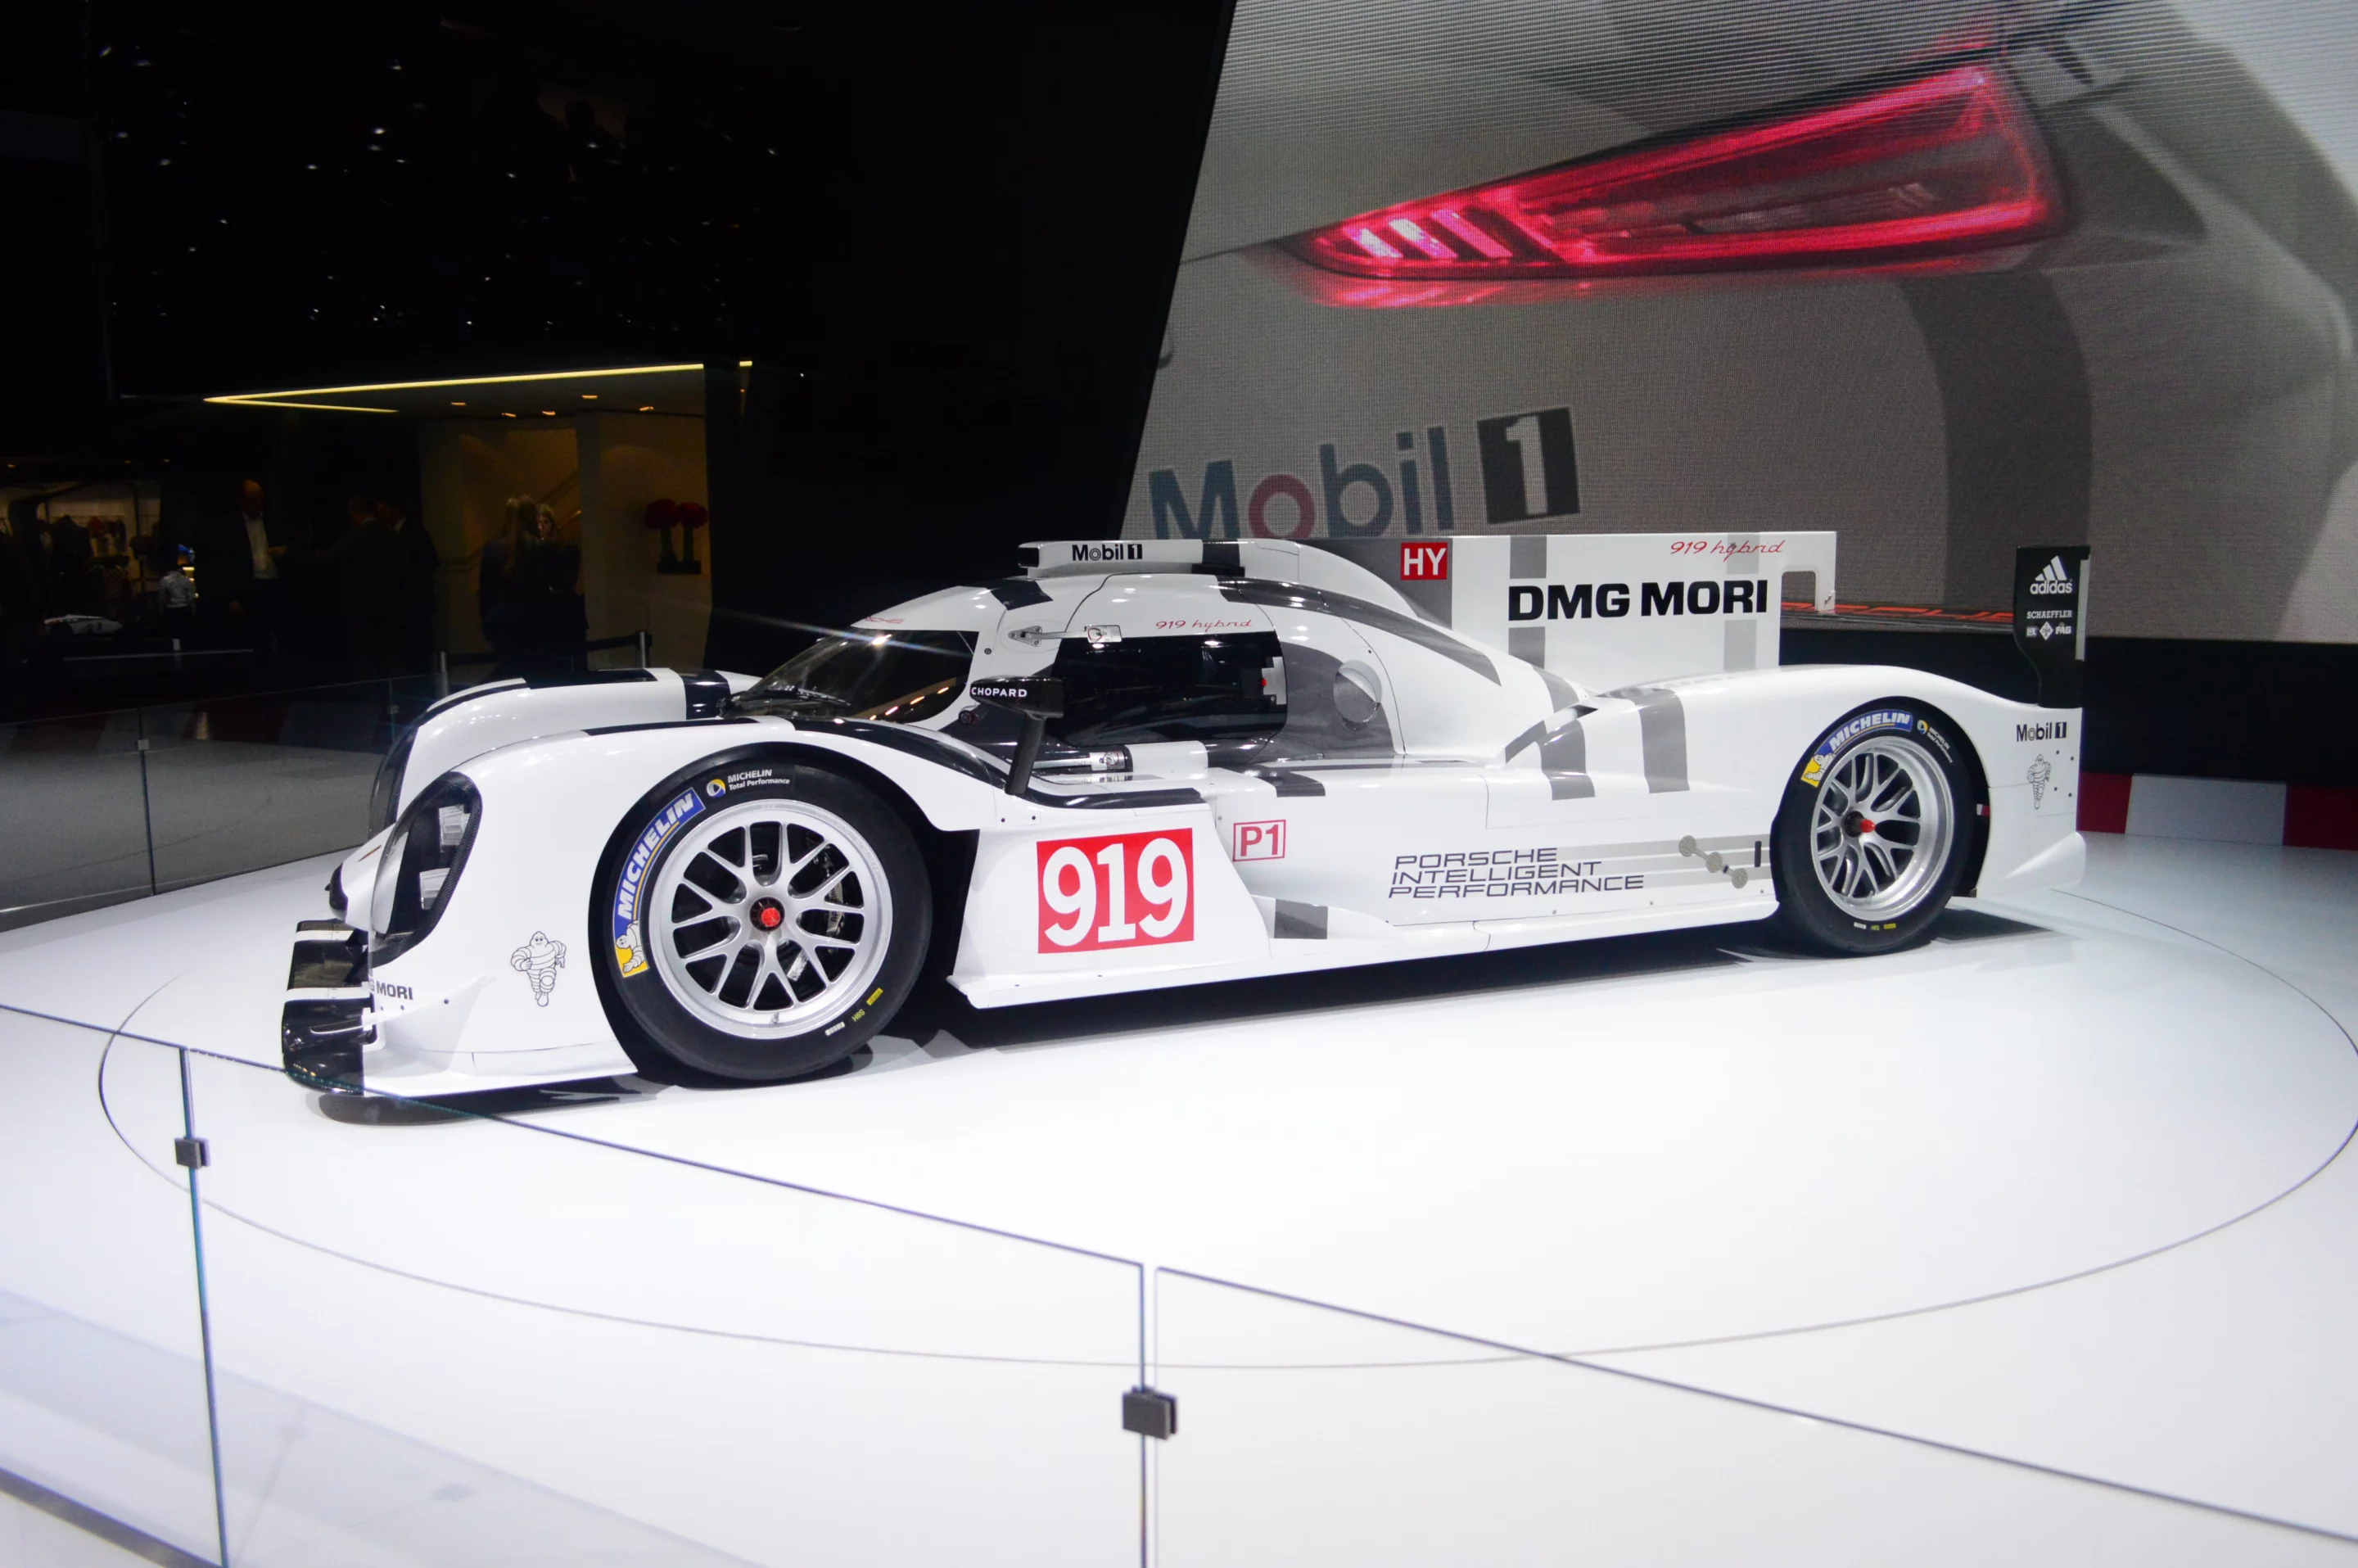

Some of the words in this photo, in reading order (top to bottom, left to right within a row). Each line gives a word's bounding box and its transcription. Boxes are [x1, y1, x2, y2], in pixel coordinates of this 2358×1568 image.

[1149, 426, 1454, 539] Mobil
[1072, 544, 1124, 561] Mobil
[1403, 547, 1448, 576] HY
[1670, 540, 1707, 555] 919
[1710, 539, 1786, 563] hybrid
[2030, 580, 2073, 594] adidas
[1508, 584, 1630, 621] DMG
[1641, 580, 1768, 617] MORI
[1155, 620, 1186, 630] 919
[1191, 619, 1252, 633] hybrid
[2026, 610, 2072, 619] SCHAEFFLER
[971, 687, 1028, 698] CHOPARD
[1828, 712, 1911, 752] MICHELIN
[2017, 722, 2053, 742] Mobil
[727, 769, 773, 783] MICHELIN
[728, 780, 746, 791] Total
[747, 778, 791, 787] Performance
[1240, 824, 1279, 857] P1
[617, 792, 695, 921] MICHELIN
[1394, 847, 1558, 870] PORSCHE
[1391, 861, 1602, 885] INTELLIGENT
[1042, 837, 1188, 947] 919
[1388, 875, 1645, 899] PERFORMANCE
[377, 980, 413, 1000] MORI
